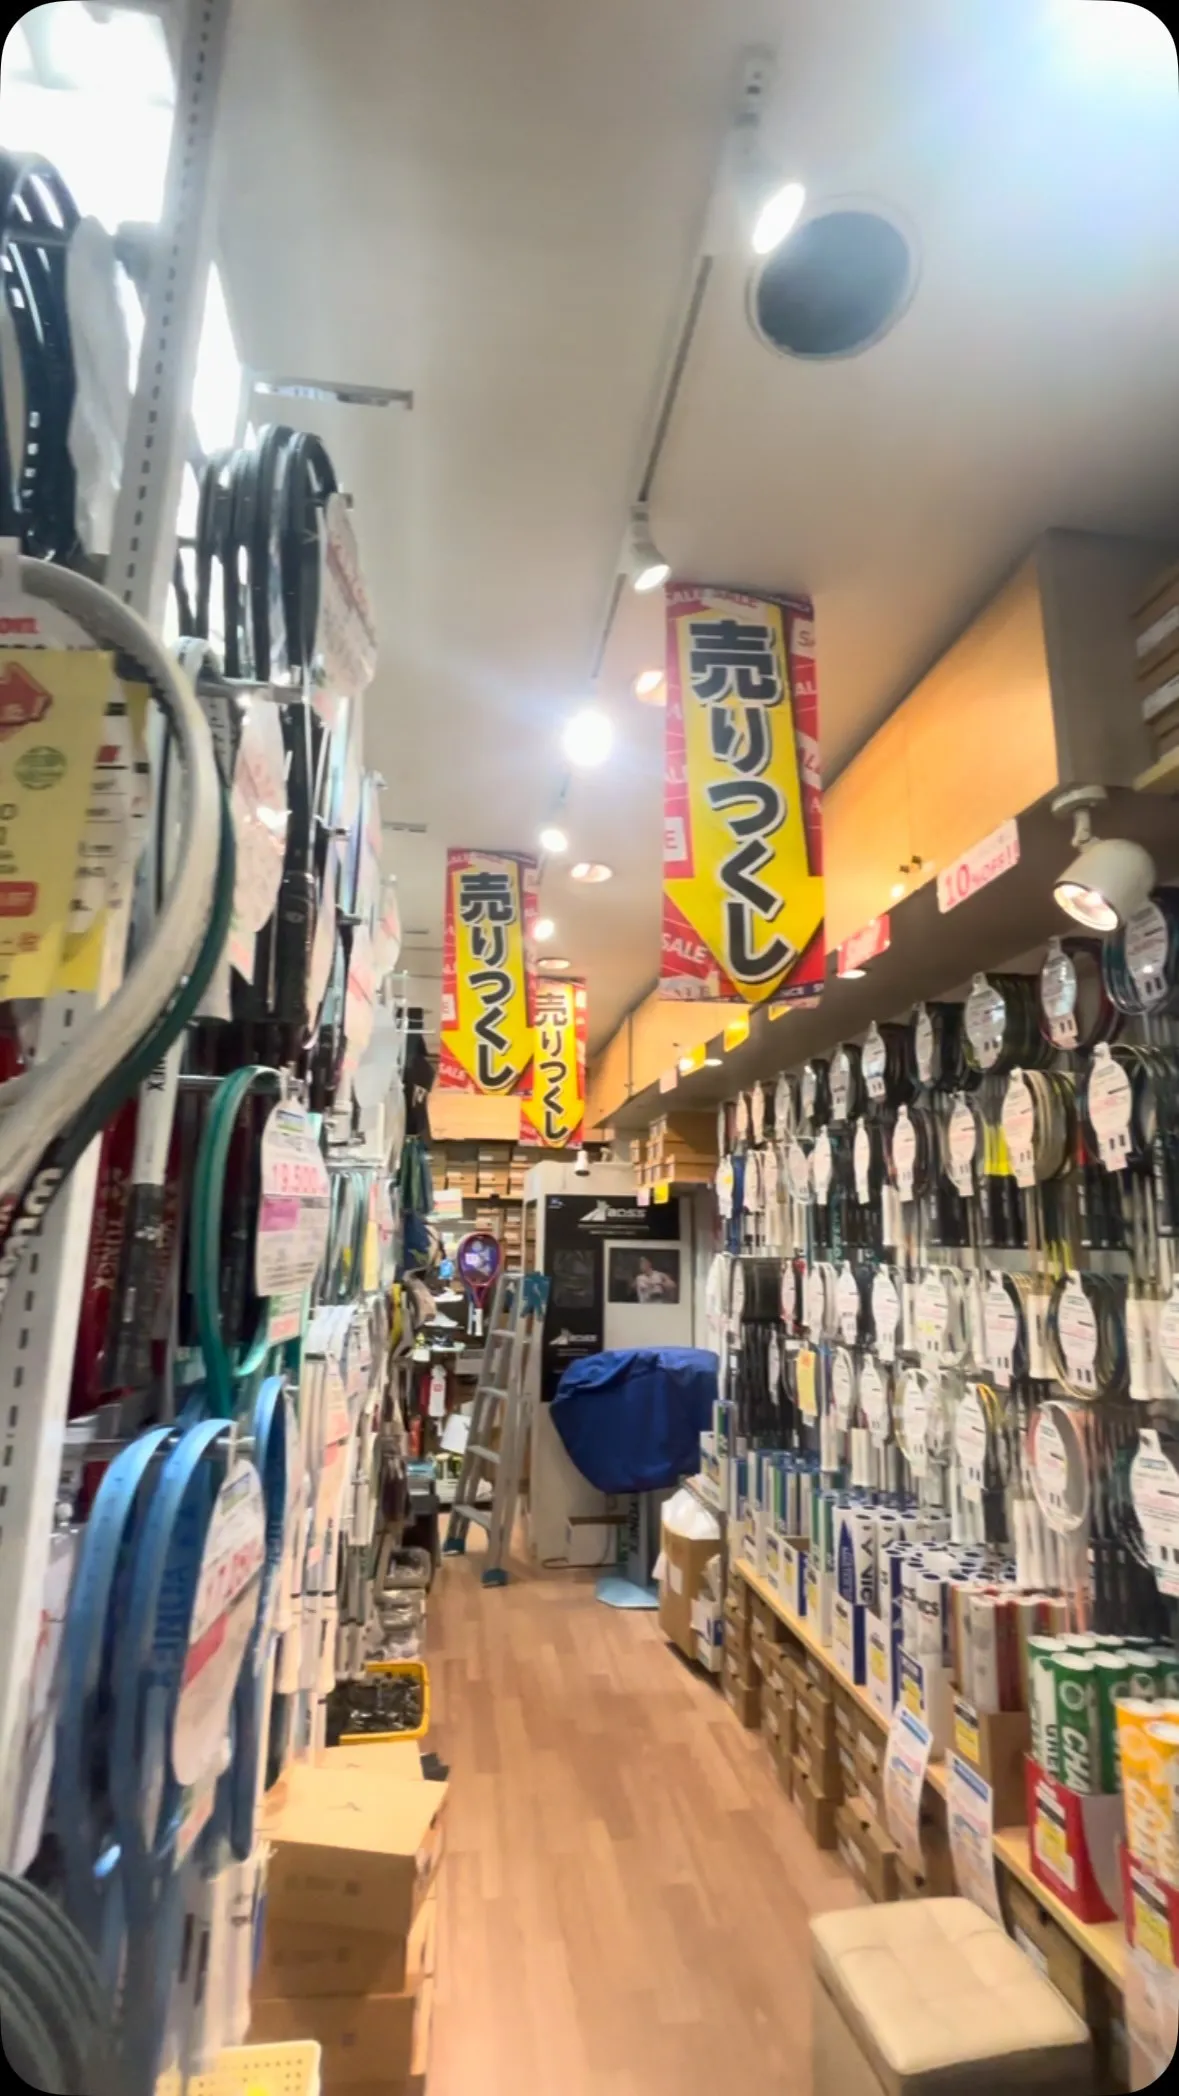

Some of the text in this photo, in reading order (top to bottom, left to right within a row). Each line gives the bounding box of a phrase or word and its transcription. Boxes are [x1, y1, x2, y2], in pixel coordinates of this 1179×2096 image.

[688, 619, 794, 979] 売りつくし
[459, 871, 516, 1089] 売りつくし
[661, 932, 709, 965] SALE
[535, 992, 569, 1141] 売りつくし
